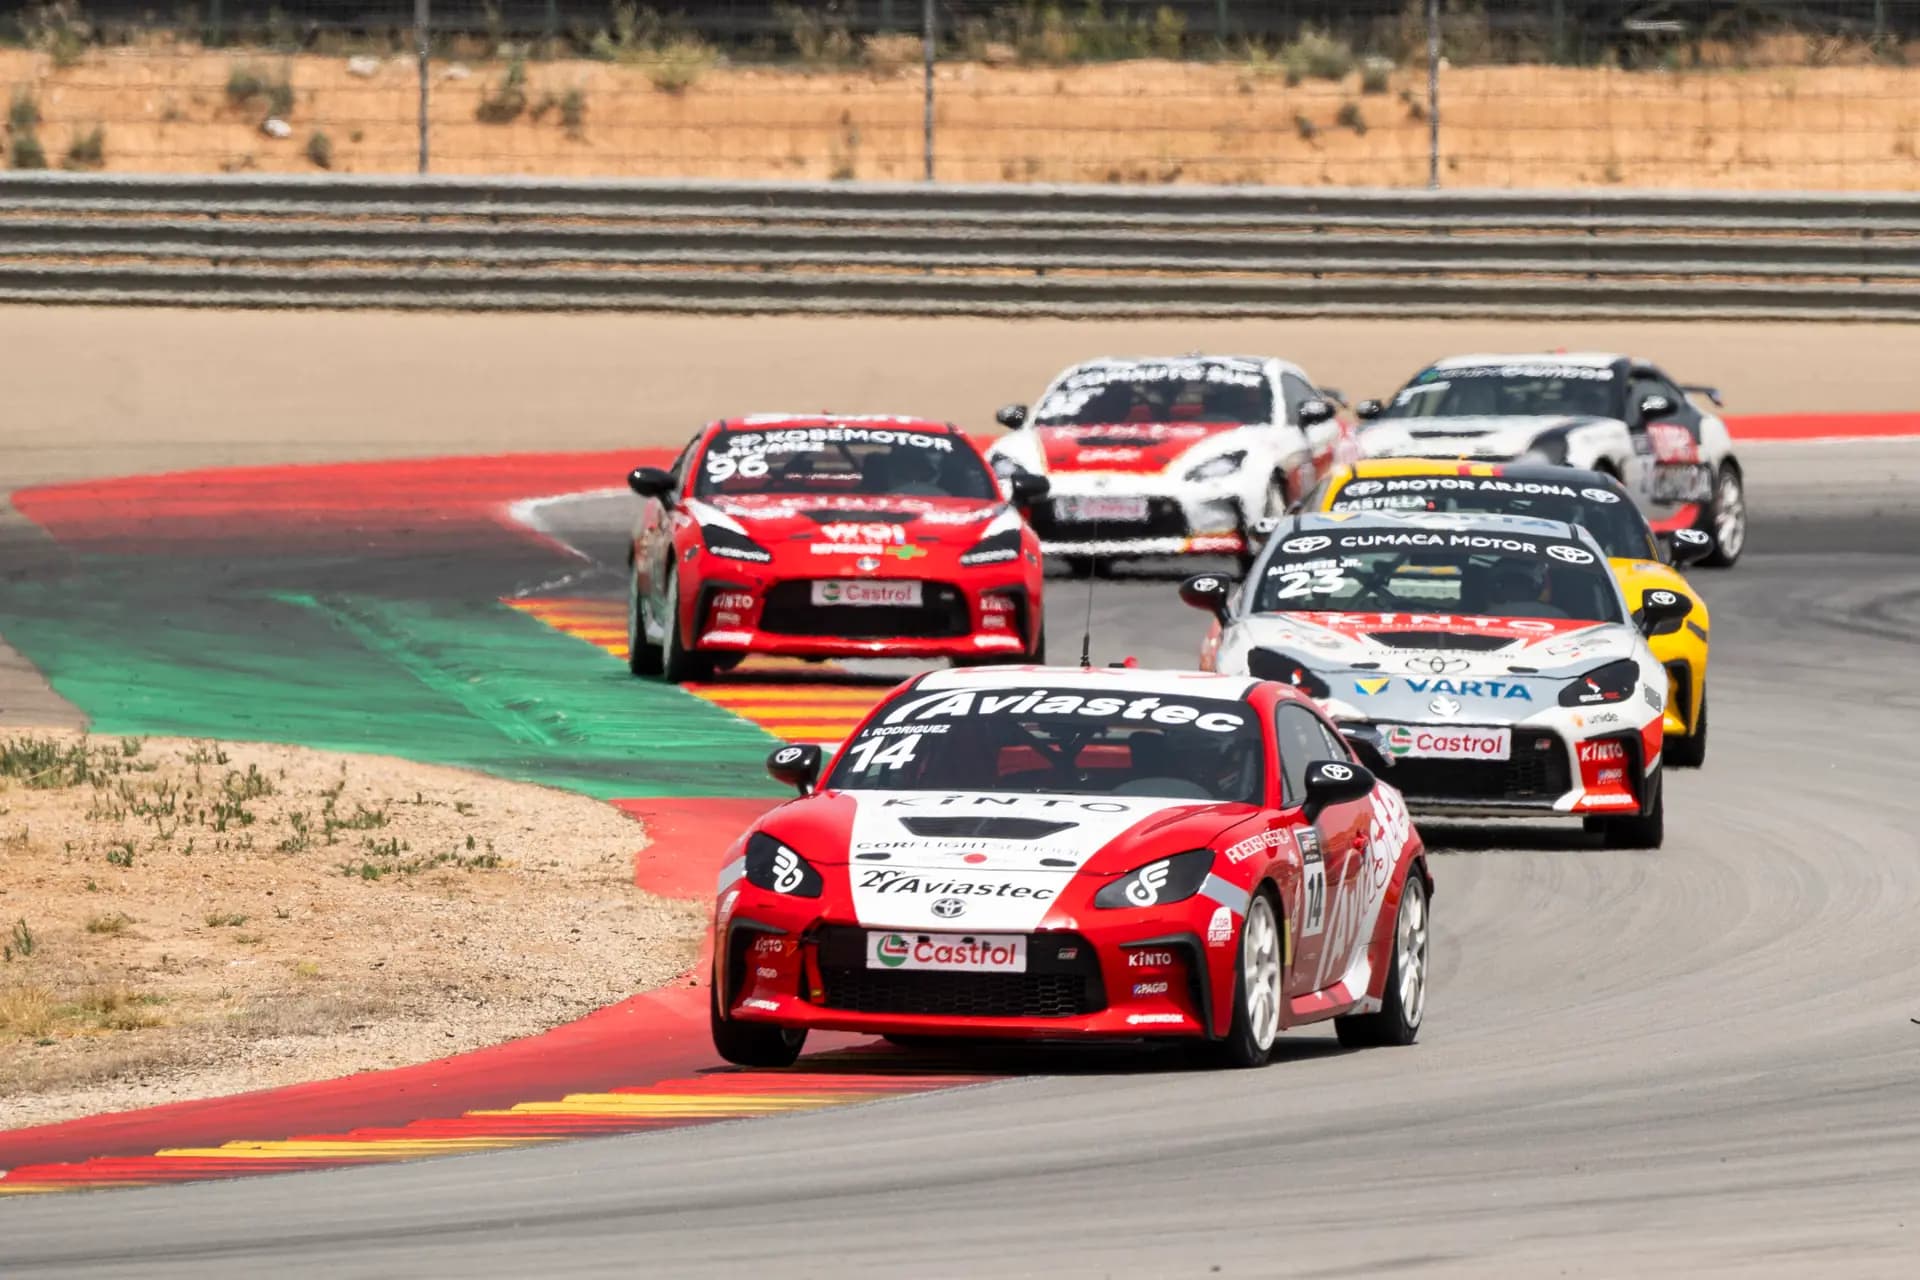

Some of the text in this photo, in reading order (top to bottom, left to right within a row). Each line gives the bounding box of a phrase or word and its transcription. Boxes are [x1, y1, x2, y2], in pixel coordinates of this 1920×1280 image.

[706, 453, 769, 483] 96
[1387, 478, 1577, 497] MOTOR ARJONA
[1340, 534, 1537, 553] CUMACA MOTOR
[846, 581, 912, 601] Castrol
[1277, 567, 1345, 599] 23
[1406, 679, 1532, 700] VARTA
[915, 689, 1244, 732] Aviastec
[872, 725, 951, 736] RODRIGUEZ
[850, 734, 922, 772] 14
[1417, 733, 1502, 753] Castrol
[895, 878, 1055, 900] Aviastec
[1306, 872, 1323, 929] 14
[914, 940, 1015, 965] Castrol
[1143, 982, 1168, 995] PAGID
